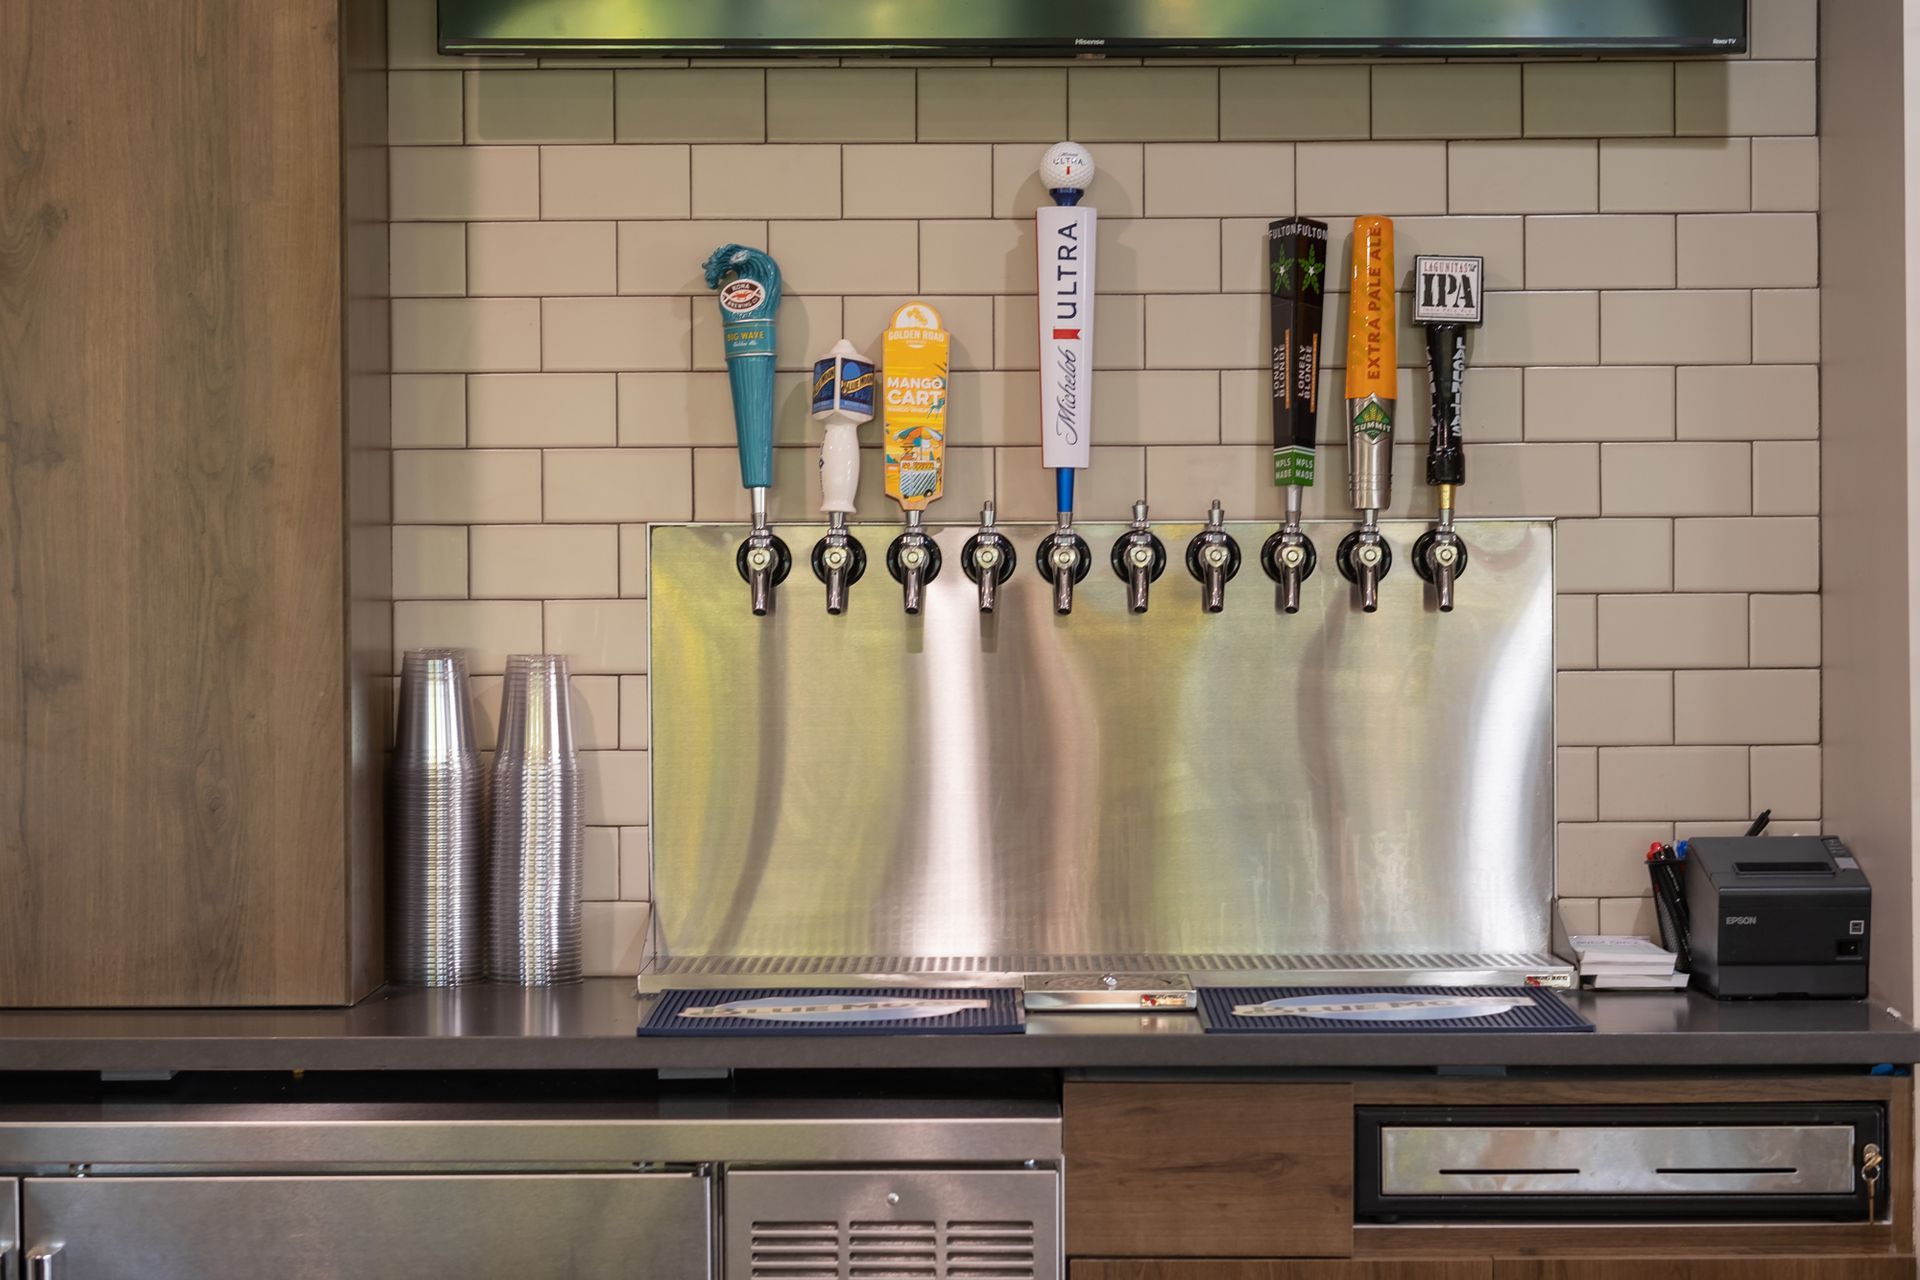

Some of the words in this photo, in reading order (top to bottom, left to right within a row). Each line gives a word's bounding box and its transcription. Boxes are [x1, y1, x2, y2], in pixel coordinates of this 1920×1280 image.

[1268, 223, 1297, 240] FULTON
[1296, 223, 1328, 240] FULTON
[1369, 227, 1381, 261] ALE
[1056, 222, 1078, 319] ULTRA
[1424, 261, 1468, 273] LAGUNITAS
[1368, 267, 1382, 312] PALE
[1421, 273, 1475, 308] IPA
[741, 331, 766, 340] WAVE
[1367, 317, 1381, 380] EXTRA
[1297, 345, 1306, 397] LONELY
[1304, 345, 1313, 399] BLONDE
[887, 376, 944, 389] MANGO
[887, 389, 943, 406] CART
[1056, 346, 1078, 446] Michelob
[1353, 421, 1392, 433] SUMMIT
[1275, 457, 1292, 468] MPLS
[1295, 457, 1313, 469] MPLS
[1275, 468, 1292, 480] MADE
[1295, 469, 1313, 480] MADE
[1726, 916, 1757, 925] EPSON
